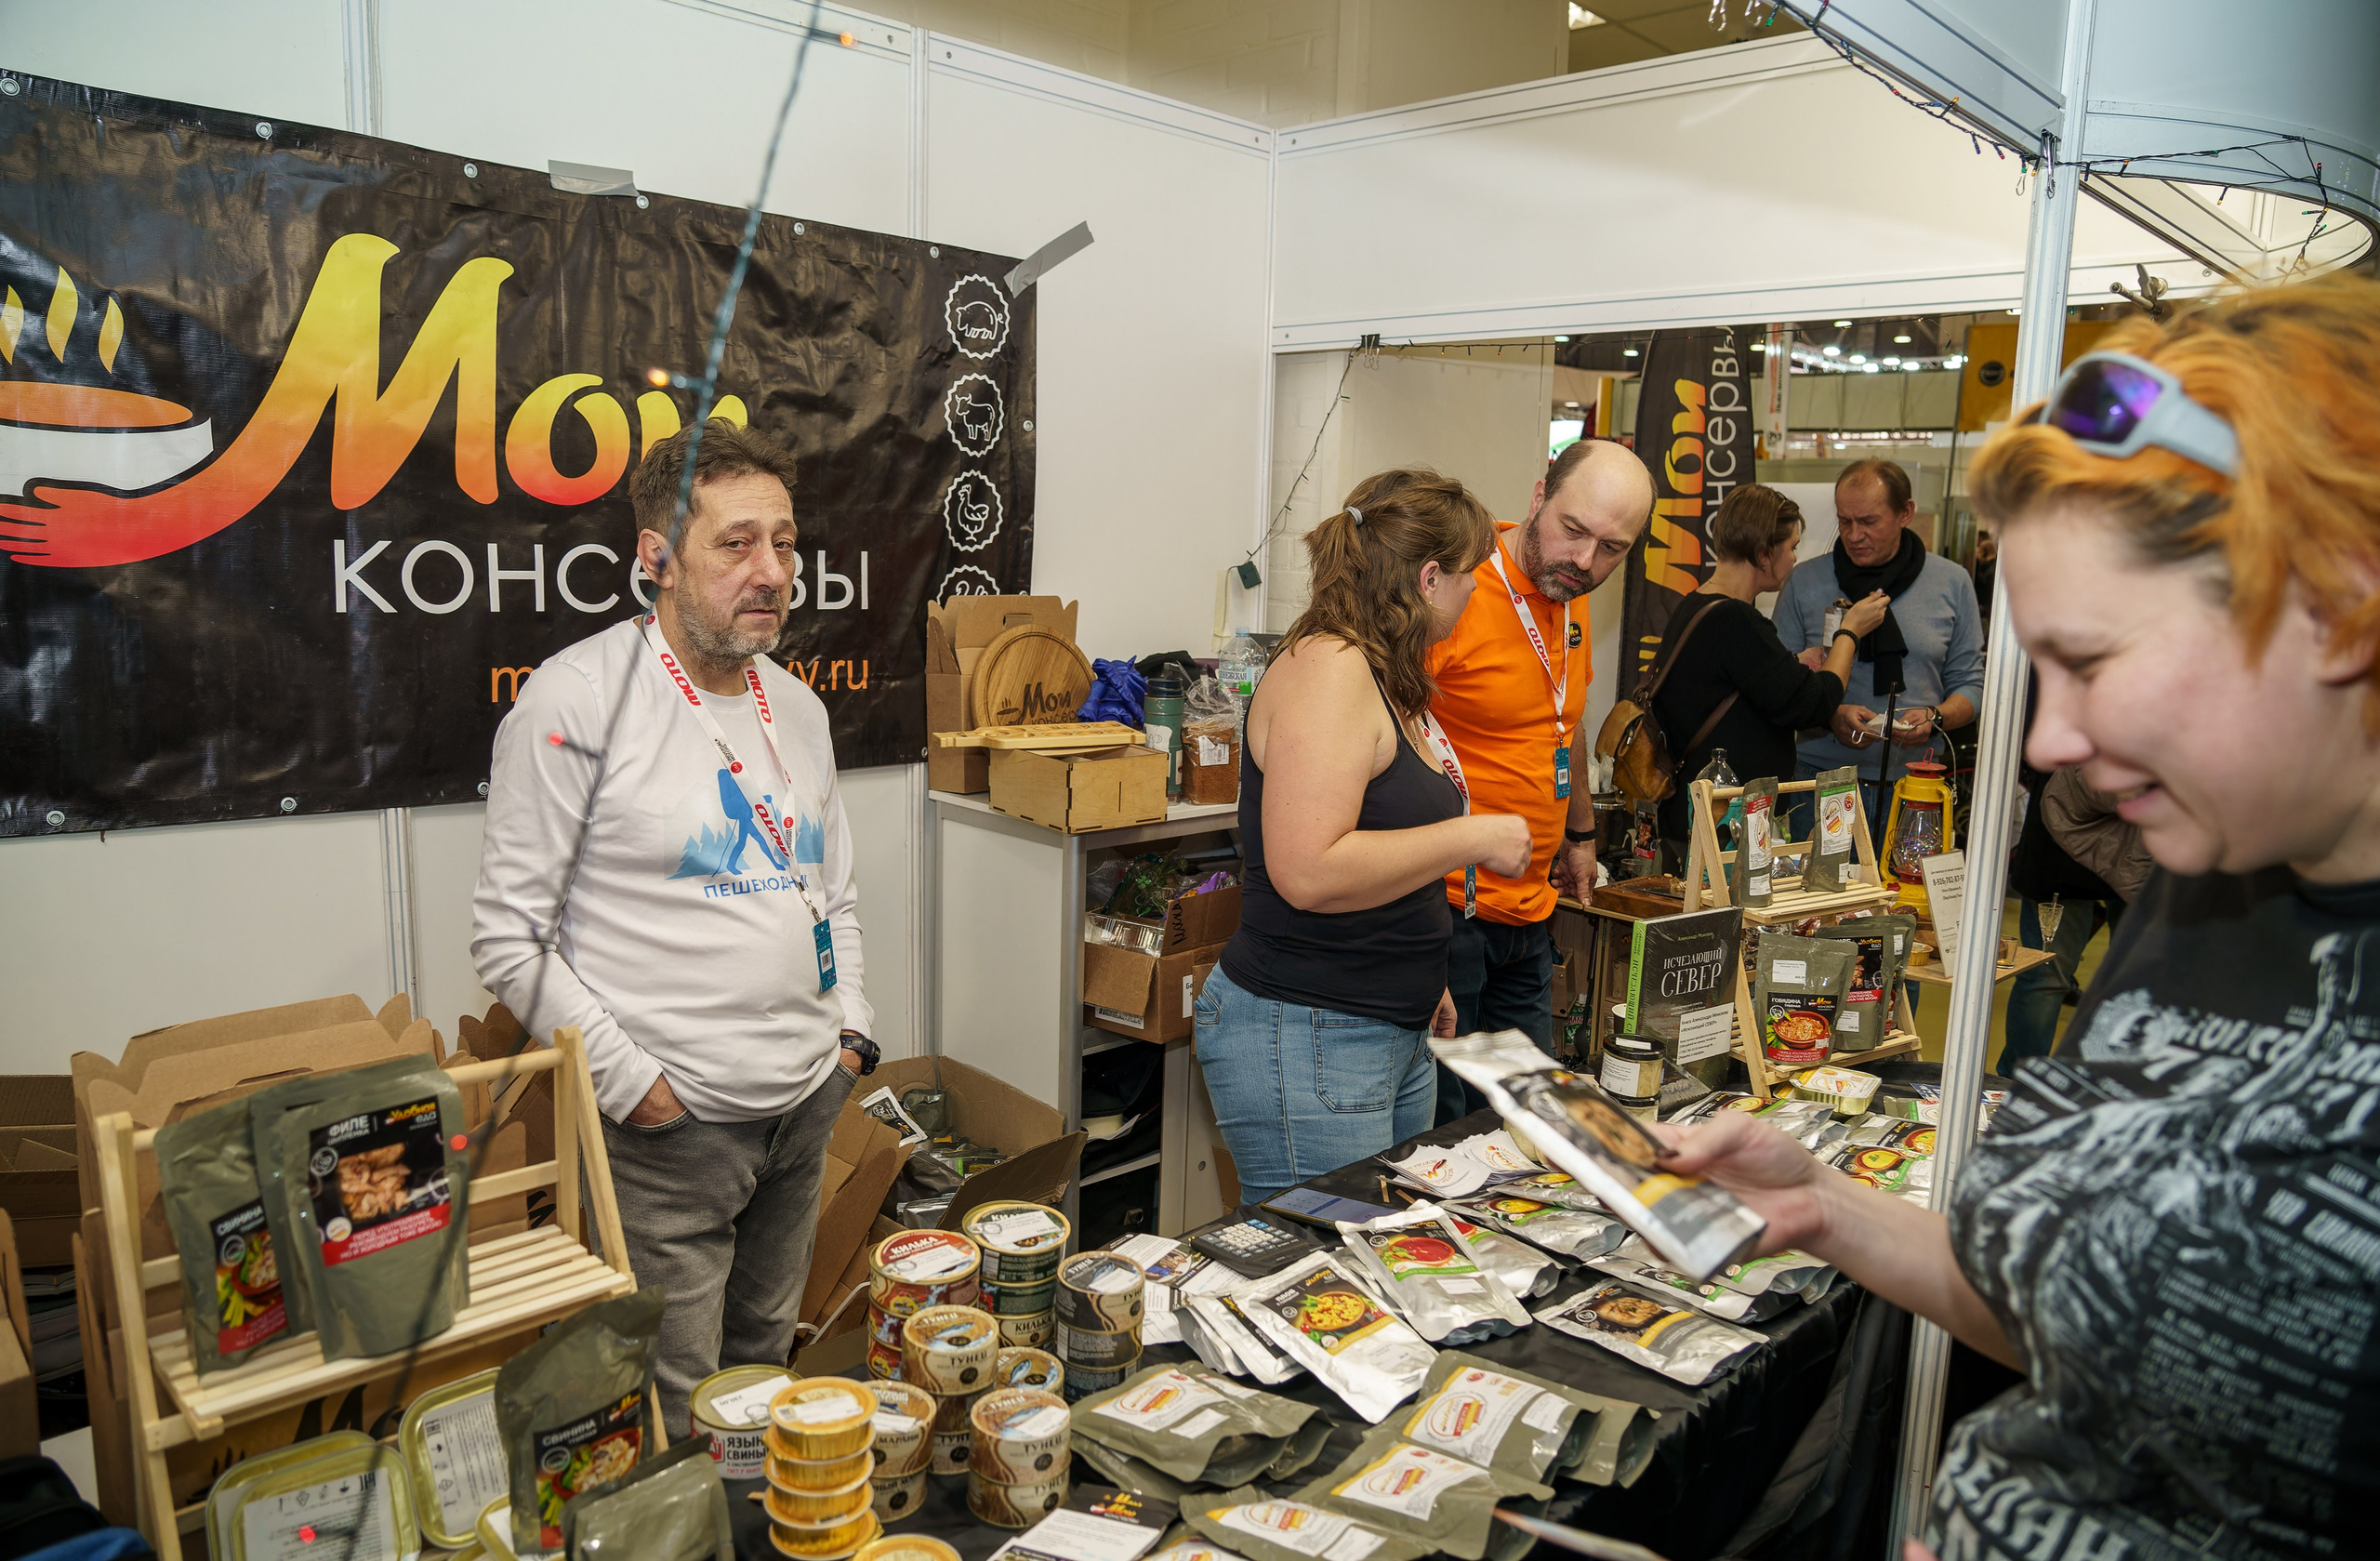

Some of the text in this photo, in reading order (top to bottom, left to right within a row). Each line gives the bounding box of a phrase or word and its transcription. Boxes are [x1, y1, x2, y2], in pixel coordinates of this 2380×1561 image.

[214, 232, 748, 516] Мо
[660, 653, 702, 707] MOTO
[747, 669, 773, 724] MOTO
[1019, 681, 1072, 719] Мои
[1442, 759, 1468, 800] MOTO
[754, 803, 789, 858] MOTO
[1663, 946, 1723, 970] ИСЧЕЗАЮЩИЙ
[1660, 962, 1723, 998] СЕВЕР
[390, 1102, 436, 1121] Удобная
[327, 1128, 370, 1145] ЦЫПЛЕНКА
[328, 1115, 369, 1137] ФИЛЕ
[891, 1236, 939, 1255] КИЛЬКА
[1275, 1288, 1296, 1301] ПЛОВ
[1015, 1315, 1051, 1331] КИЛЬКА
[950, 1350, 987, 1366] ТУНЕЦ
[989, 1396, 1025, 1410] ТУНЕЦ
[542, 1418, 597, 1447] СВИНИНА
[1024, 1435, 1063, 1453] ТУНЕЦ
